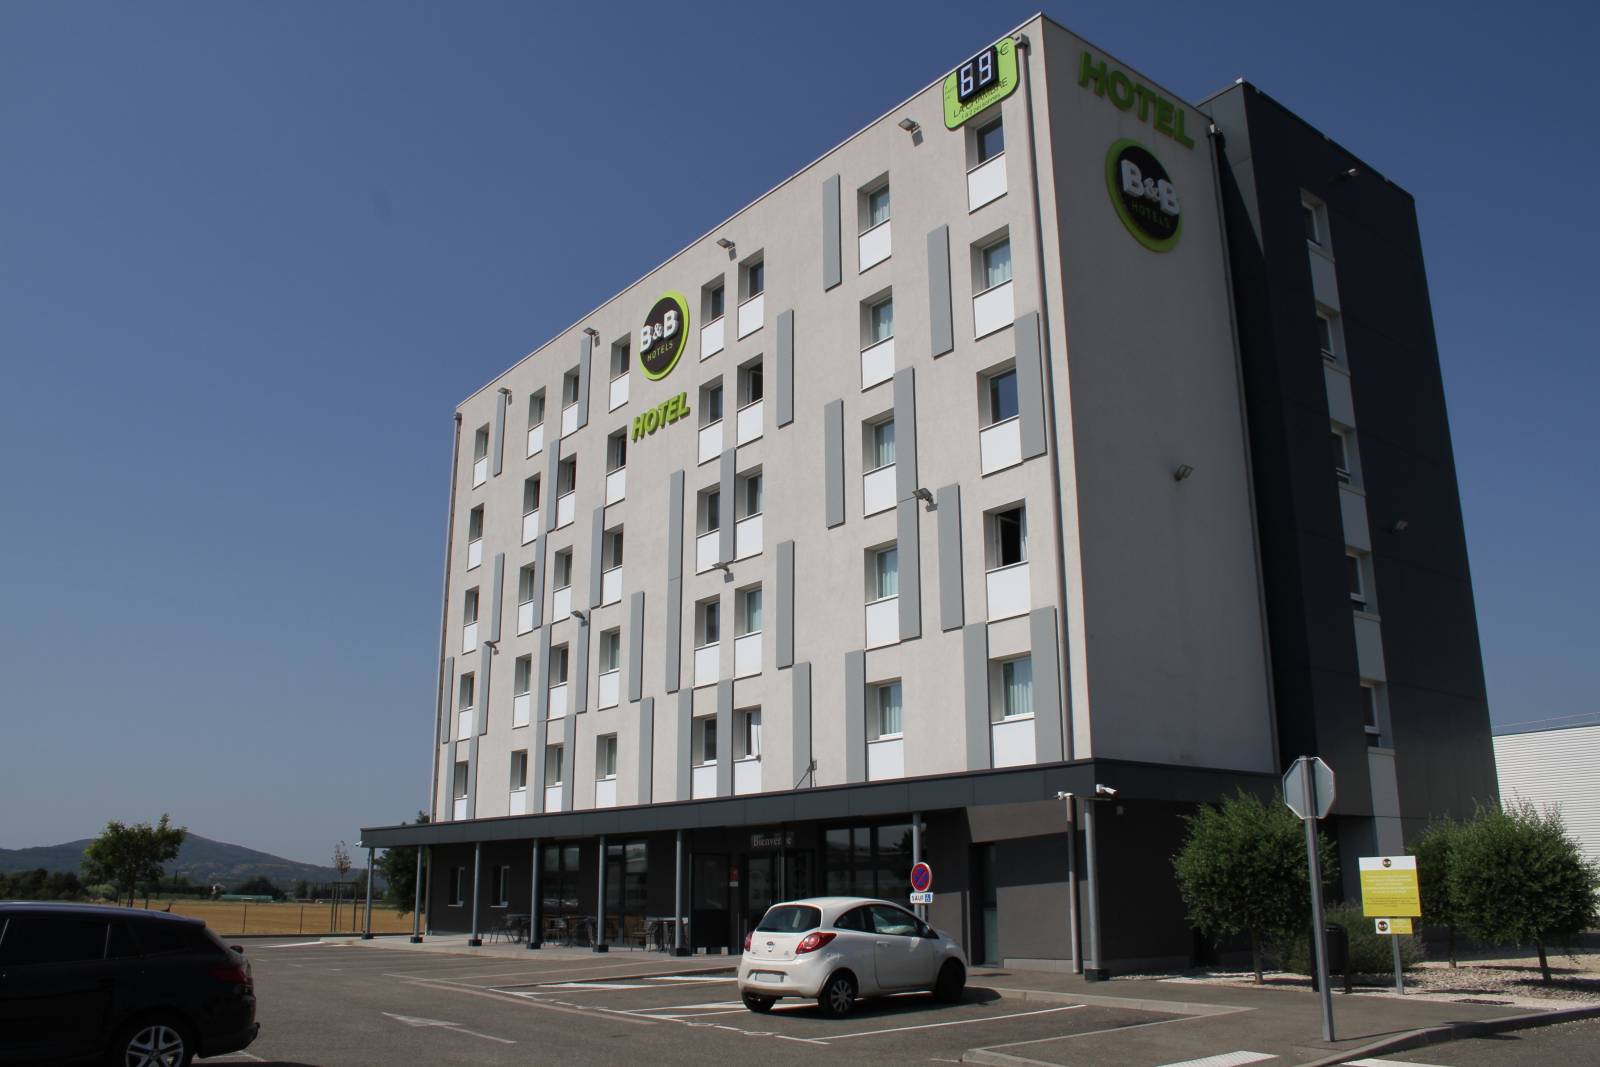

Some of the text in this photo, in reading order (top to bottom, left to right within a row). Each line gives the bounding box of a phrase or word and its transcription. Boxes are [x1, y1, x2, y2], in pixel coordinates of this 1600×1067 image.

[960, 50, 992, 97] 69
[1078, 51, 1195, 150] HOTEL
[1120, 159, 1180, 216] B&B
[640, 309, 680, 353] B&B
[647, 342, 674, 362] HOTELS
[631, 391, 690, 443] HOTEL
